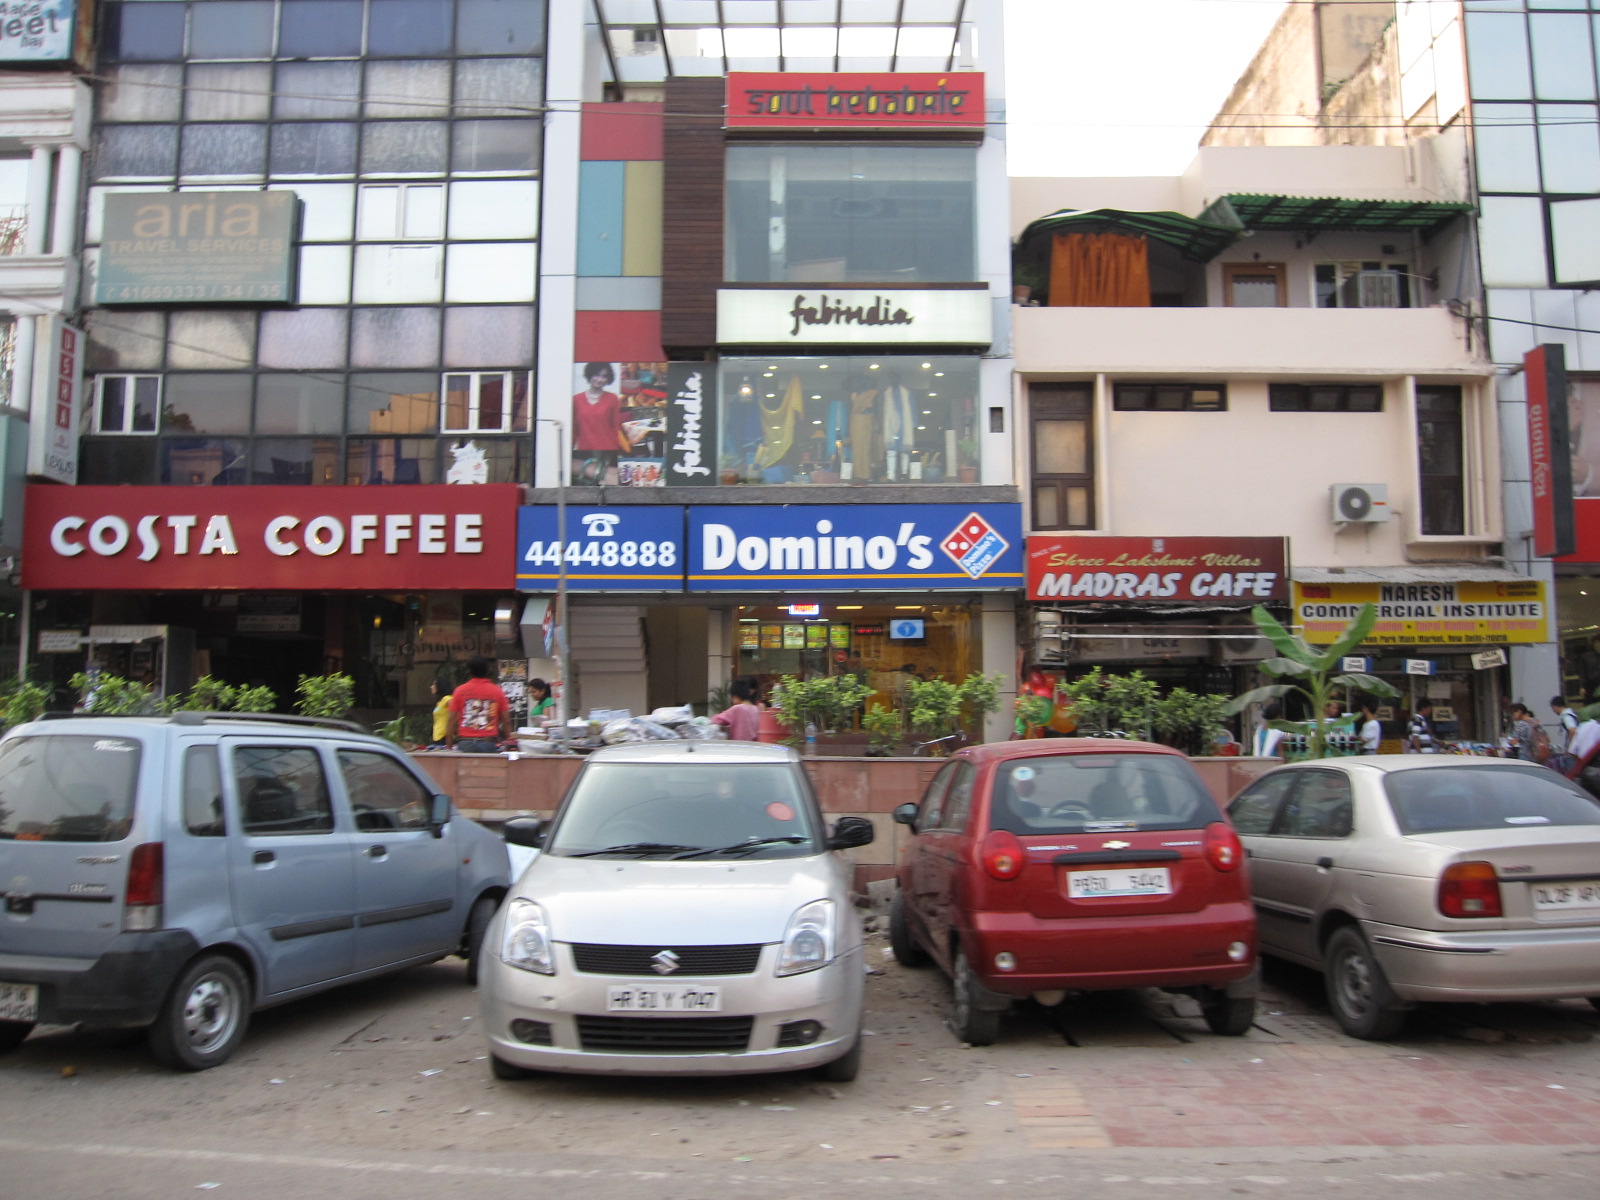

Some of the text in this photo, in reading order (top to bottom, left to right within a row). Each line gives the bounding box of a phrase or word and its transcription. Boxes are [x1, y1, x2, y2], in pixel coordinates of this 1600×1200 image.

[0, 9, 58, 39] eet
[132, 193, 259, 238] aria
[109, 239, 283, 254] TRAVEL SERVICES
[790, 294, 914, 336] fabindia
[672, 371, 711, 477] fabindia
[50, 514, 484, 562] COSTA COFFEE
[702, 519, 934, 571] Domino's
[961, 535, 997, 567] Domino's
[524, 541, 677, 567] 44448888
[1047, 553, 1262, 567] Shree Lakshmi Villas
[1036, 572, 1183, 599] MADRAS
[1190, 572, 1277, 597] CAFE
[1382, 586, 1455, 602] NARESH
[1444, 603, 1539, 616] INSTITUTE
